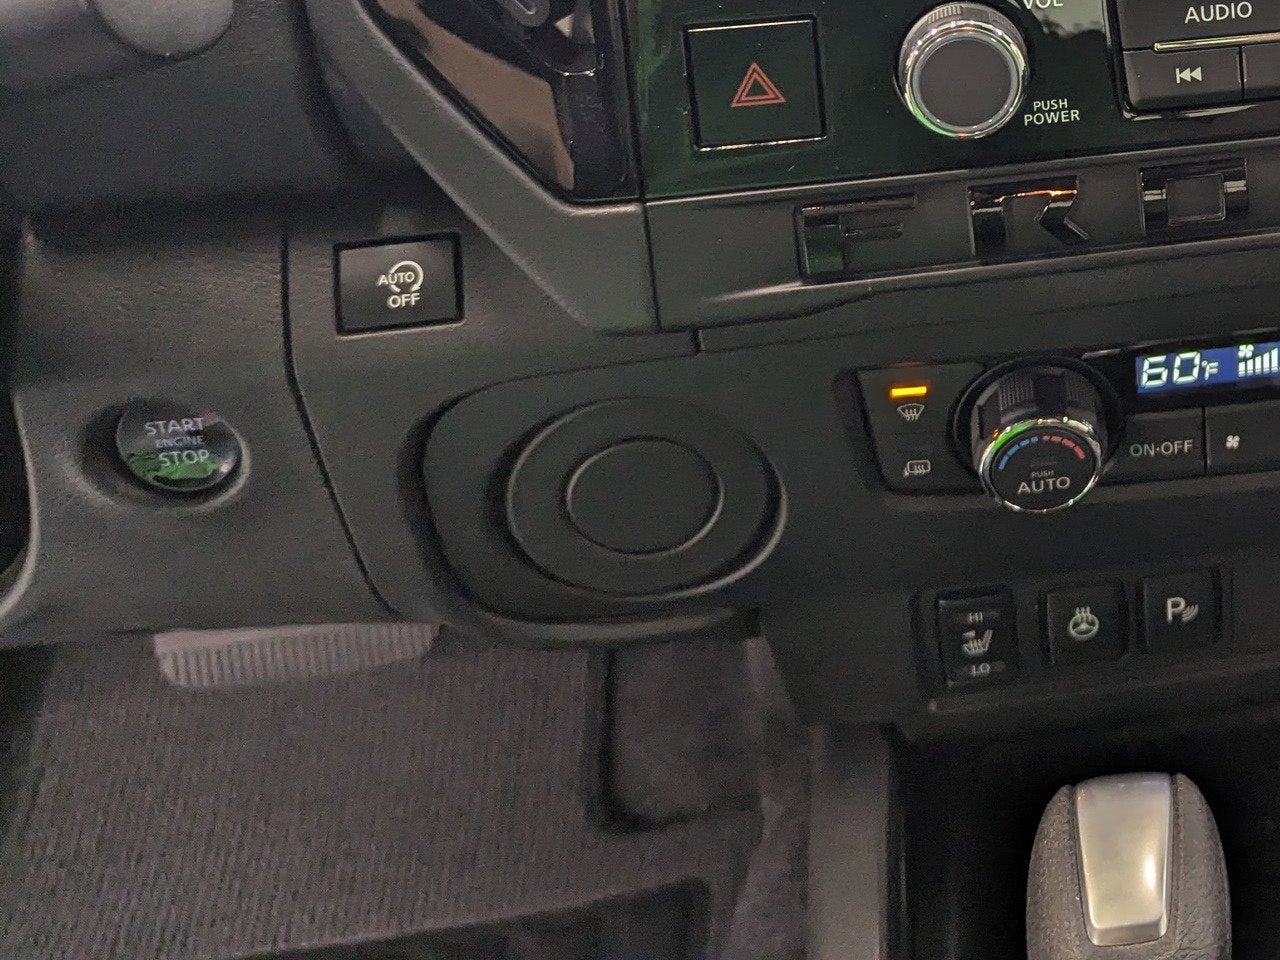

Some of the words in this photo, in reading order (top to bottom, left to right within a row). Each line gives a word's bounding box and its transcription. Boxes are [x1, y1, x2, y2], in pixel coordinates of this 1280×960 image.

[1184, 1, 1254, 25] AUDIO
[1033, 98, 1069, 113] PUSH
[1023, 108, 1082, 125] POWER
[377, 270, 415, 287] AUTO
[388, 293, 421, 309] OFF
[145, 417, 205, 436] START
[159, 449, 210, 467] STOP
[1017, 476, 1072, 495] AUTO
[969, 662, 991, 677] LO
